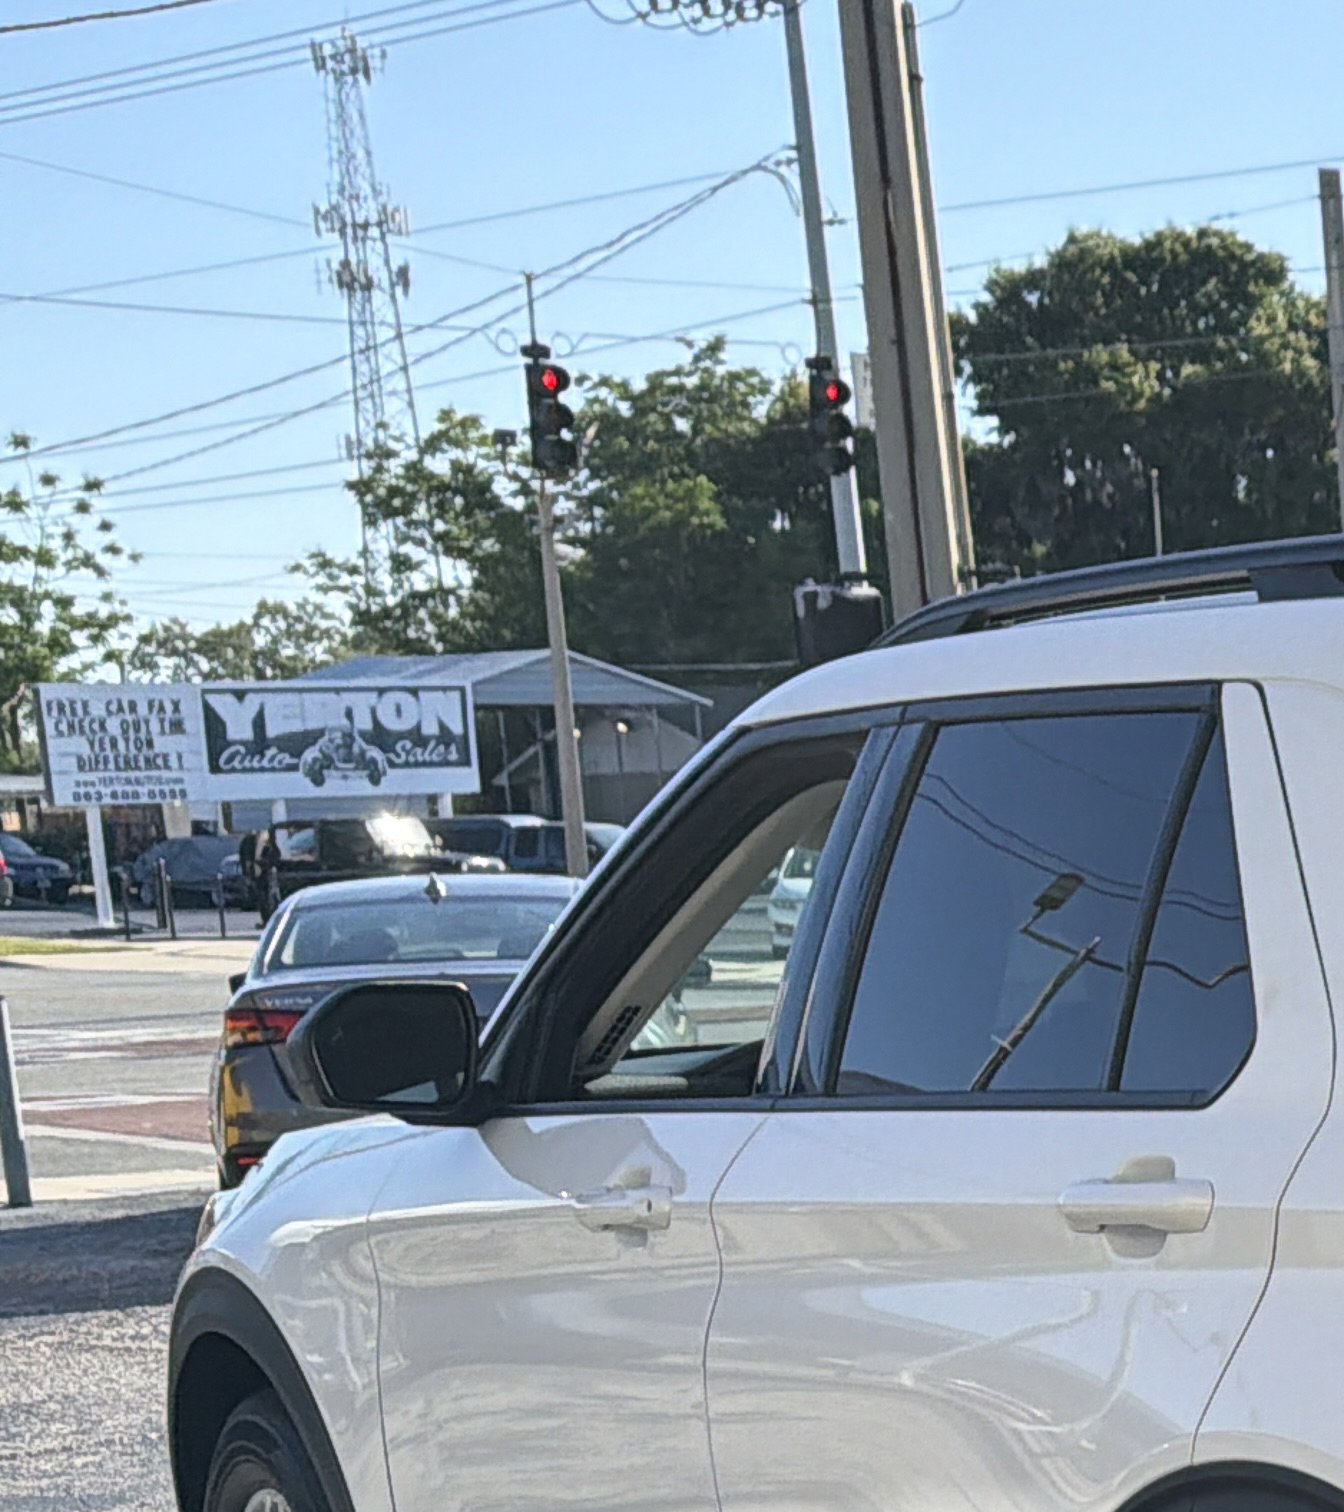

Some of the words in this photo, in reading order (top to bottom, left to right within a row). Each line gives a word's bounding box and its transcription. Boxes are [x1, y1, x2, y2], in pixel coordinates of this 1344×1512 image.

[46, 699, 90, 717] FREE
[105, 699, 138, 716] CAR
[148, 698, 181, 715] FAX
[203, 690, 465, 742] YERTON
[54, 717, 108, 737] CHECK
[120, 717, 152, 735] OUT
[159, 717, 187, 735] THE
[86, 735, 155, 753] YERTON
[218, 744, 300, 770] Auto
[388, 739, 460, 764] Sales
